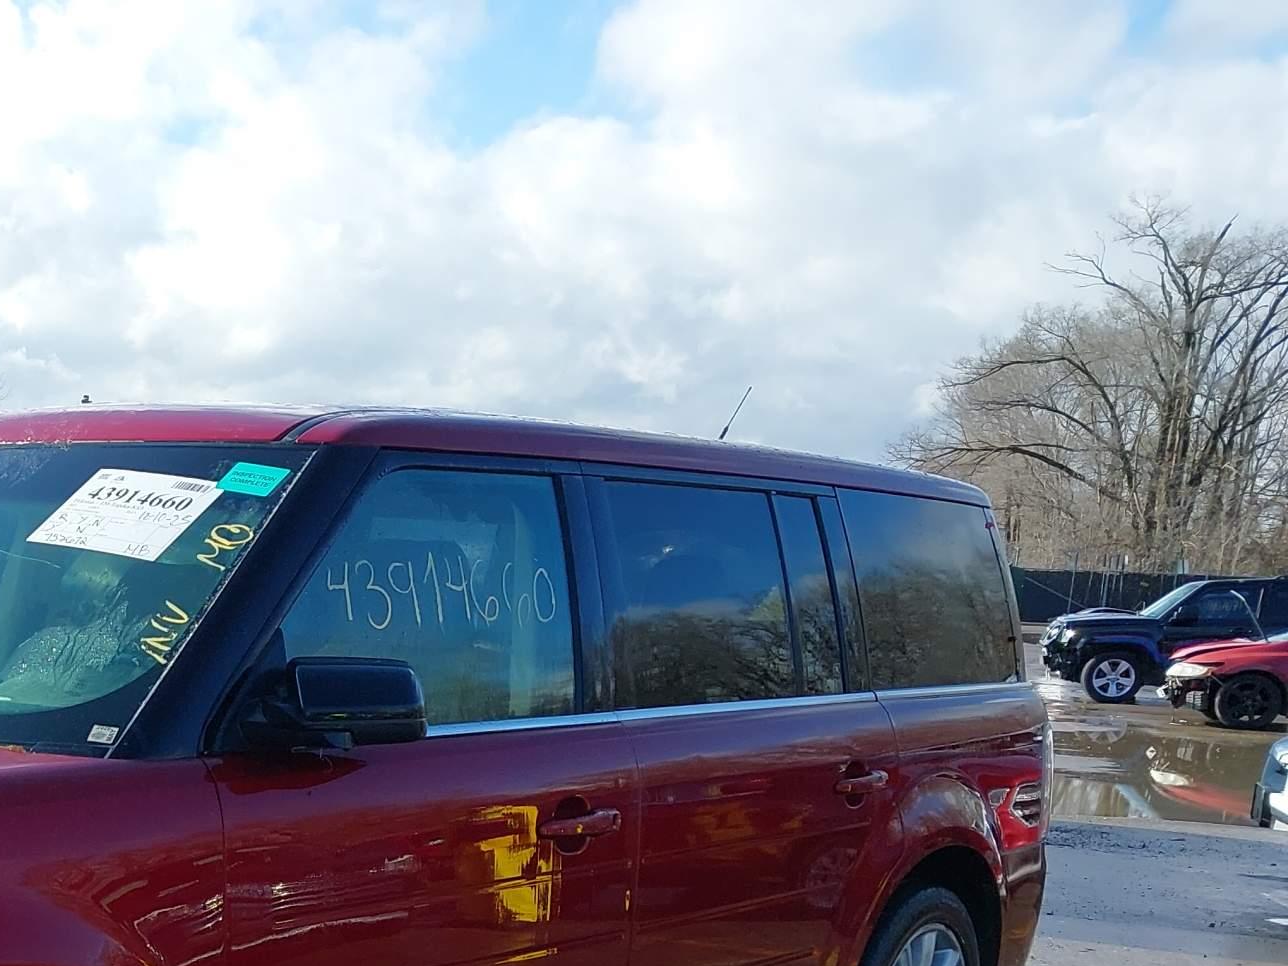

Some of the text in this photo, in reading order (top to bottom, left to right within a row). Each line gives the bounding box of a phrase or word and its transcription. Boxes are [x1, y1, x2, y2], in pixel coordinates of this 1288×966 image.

[230, 477, 271, 488] COMPLETE
[231, 470, 277, 482] INSPECTION
[87, 486, 194, 511] 43914660
[326, 551, 557, 630] 43914660
[139, 599, 190, 665] INV
